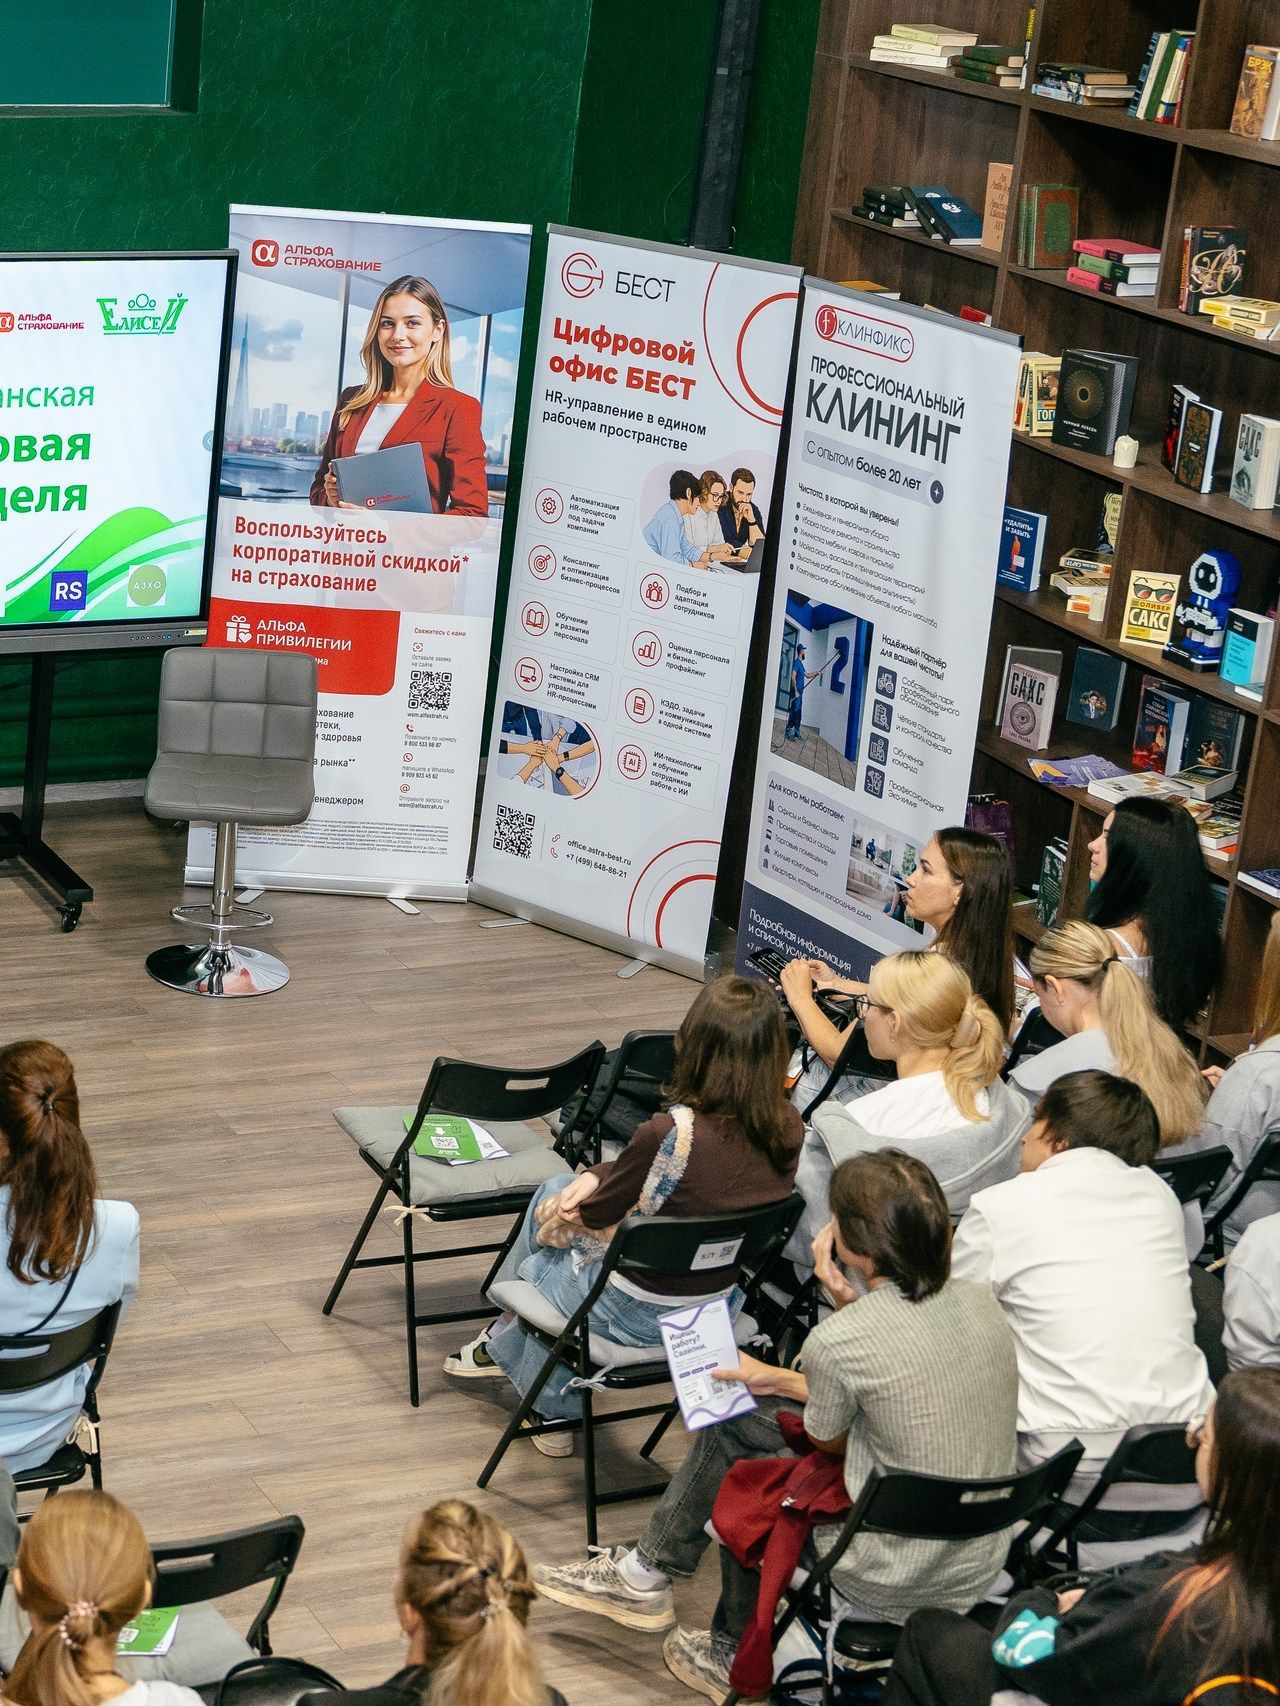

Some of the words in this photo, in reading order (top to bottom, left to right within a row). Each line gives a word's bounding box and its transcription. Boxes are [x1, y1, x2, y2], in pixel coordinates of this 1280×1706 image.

[284, 244, 334, 257] АЛЬФА
[284, 256, 382, 272] СТРАХОВАНИЕ
[615, 271, 676, 302] БЕСТ
[17, 313, 52, 322] АЛЬФА
[17, 321, 84, 330] СТРАХОВАНИЕ
[553, 317, 696, 366] Цифровой
[838, 320, 911, 354] КЛИНФИКС
[549, 355, 618, 384] офис
[626, 367, 696, 400] БЕСТ
[811, 355, 965, 419] ПРОФЕССИОНАЛЬНЫЙ
[545, 389, 644, 422] HR-управление
[647, 414, 654, 423] в
[657, 416, 707, 435] едином
[806, 379, 961, 464] КЛИНИНГ
[543, 411, 596, 431] рабочем
[599, 422, 688, 451] пространстве
[807, 440, 816, 454] С
[817, 446, 854, 468] опытом
[856, 457, 887, 479] более
[888, 469, 901, 484] 20
[903, 478, 921, 491] лет
[570, 494, 620, 511] Автоматизация
[830, 495, 859, 512] которой
[235, 515, 387, 545] Воспользуйтесь
[567, 524, 599, 535] компании
[581, 518, 605, 528] задачи
[232, 543, 376, 570] корпоративной
[563, 555, 600, 569] Консалтинг
[231, 568, 252, 583] на
[258, 570, 377, 592] страхование
[567, 567, 609, 581] оптимизация
[55, 580, 83, 601] RS
[560, 574, 620, 594] бизнес-процессов
[676, 584, 701, 597] Подбор
[675, 595, 708, 608] адаптация
[1140, 601, 1171, 611] ОЛИВЕР
[556, 612, 588, 625] Обучение
[673, 604, 715, 619] сотрудников
[1129, 609, 1169, 630] САКС
[256, 619, 306, 633] АЛЬФА
[560, 623, 590, 635] развитие
[256, 633, 352, 651] ПРИВИЛЕГИИ
[554, 631, 588, 644] персонала
[668, 642, 692, 654] Оценка
[694, 650, 730, 664] персонала
[882, 634, 919, 656] Надёжный
[921, 648, 947, 669] партнёр
[894, 653, 917, 669] вашей
[550, 663, 583, 678] Настройка
[666, 662, 706, 677] профайлинг
[549, 674, 576, 685] системы
[548, 682, 585, 697] управления
[665, 711, 713, 729] коммуникации
[321, 733, 362, 743] здоровья
[651, 771, 692, 787] сотрудников
[314, 796, 363, 806] енеджером
[783, 786, 798, 800] кого
[568, 840, 632, 866] office.astra-best.ru
[575, 855, 593, 868] (499)
